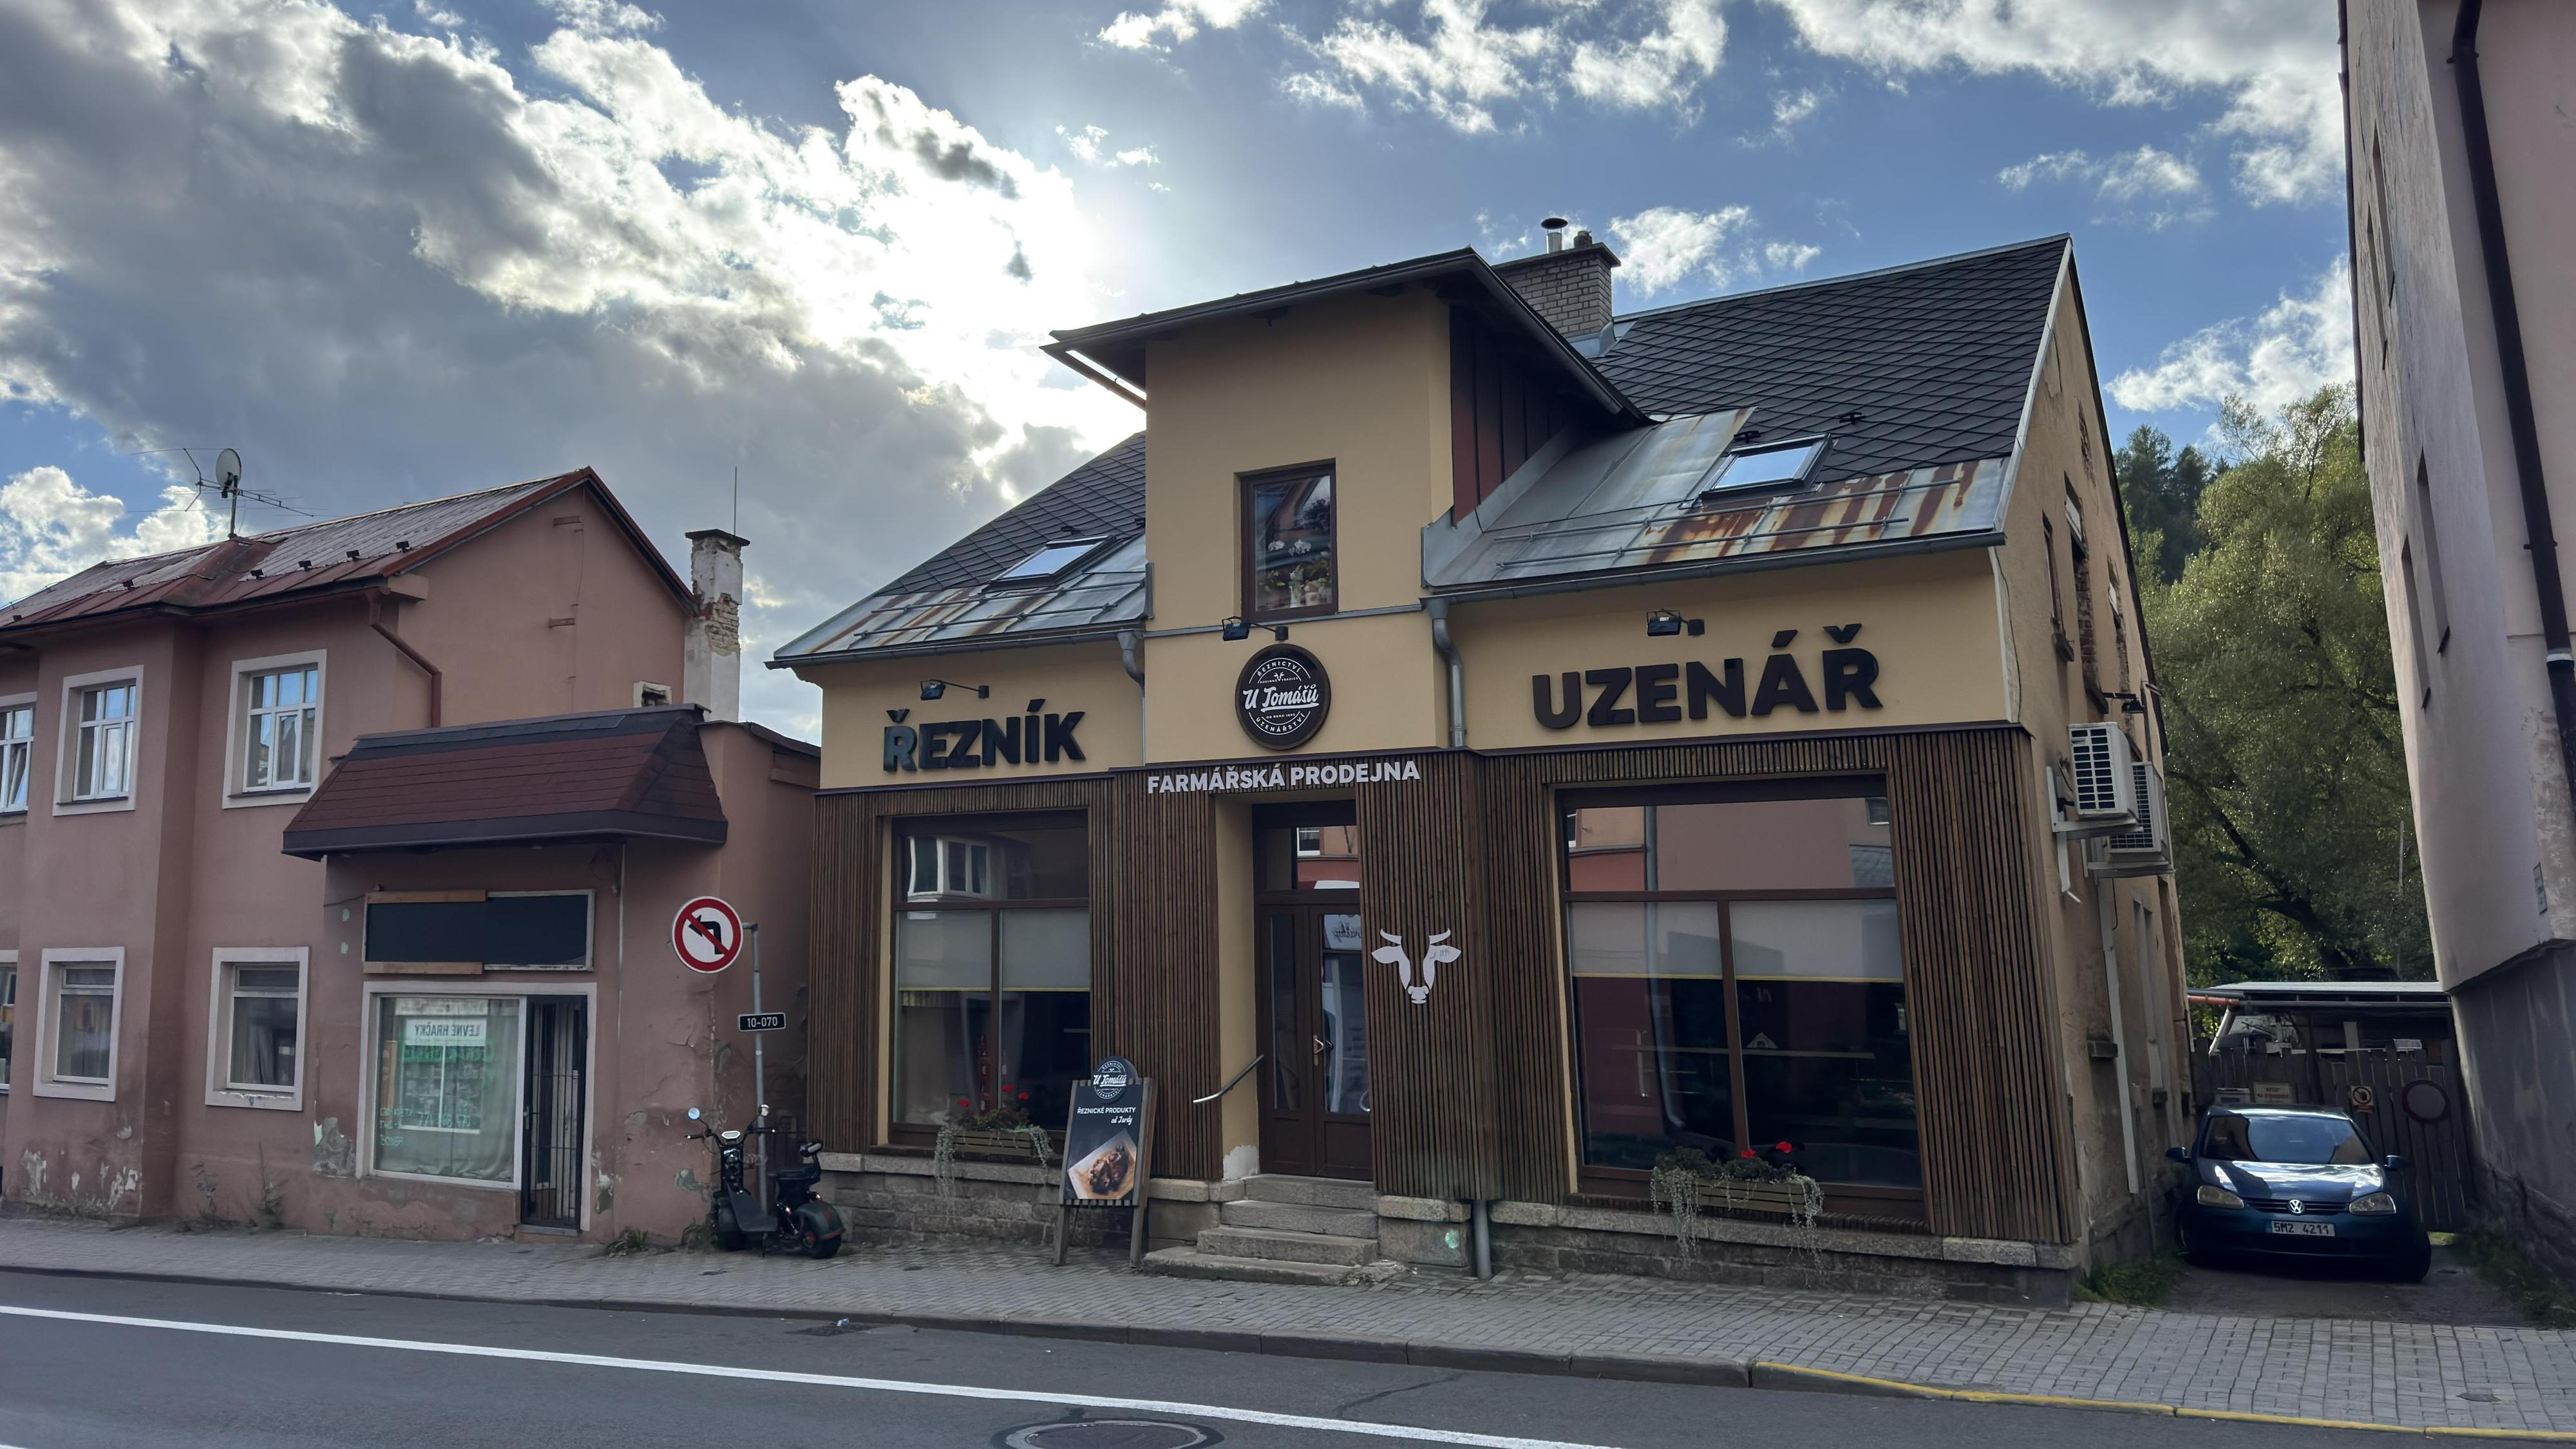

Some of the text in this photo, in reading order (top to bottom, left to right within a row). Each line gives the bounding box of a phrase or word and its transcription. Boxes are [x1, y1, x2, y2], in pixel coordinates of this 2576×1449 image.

[1257, 661, 1301, 677] ŘEZNICTVÍ
[1532, 623, 1884, 730] UZENÁŘ
[1243, 684, 1319, 710] U Tomášů
[1256, 713, 1305, 732] UZENÁŘSTVÍ
[883, 698, 1086, 772] ŘEZNÍK
[1148, 761, 1421, 794] FARMÁŘSKÁ PRODEJNA
[747, 1016, 778, 1028] 10-070
[1093, 1074, 1102, 1085] U
[2273, 1222, 2329, 1235] 5M2 4211
